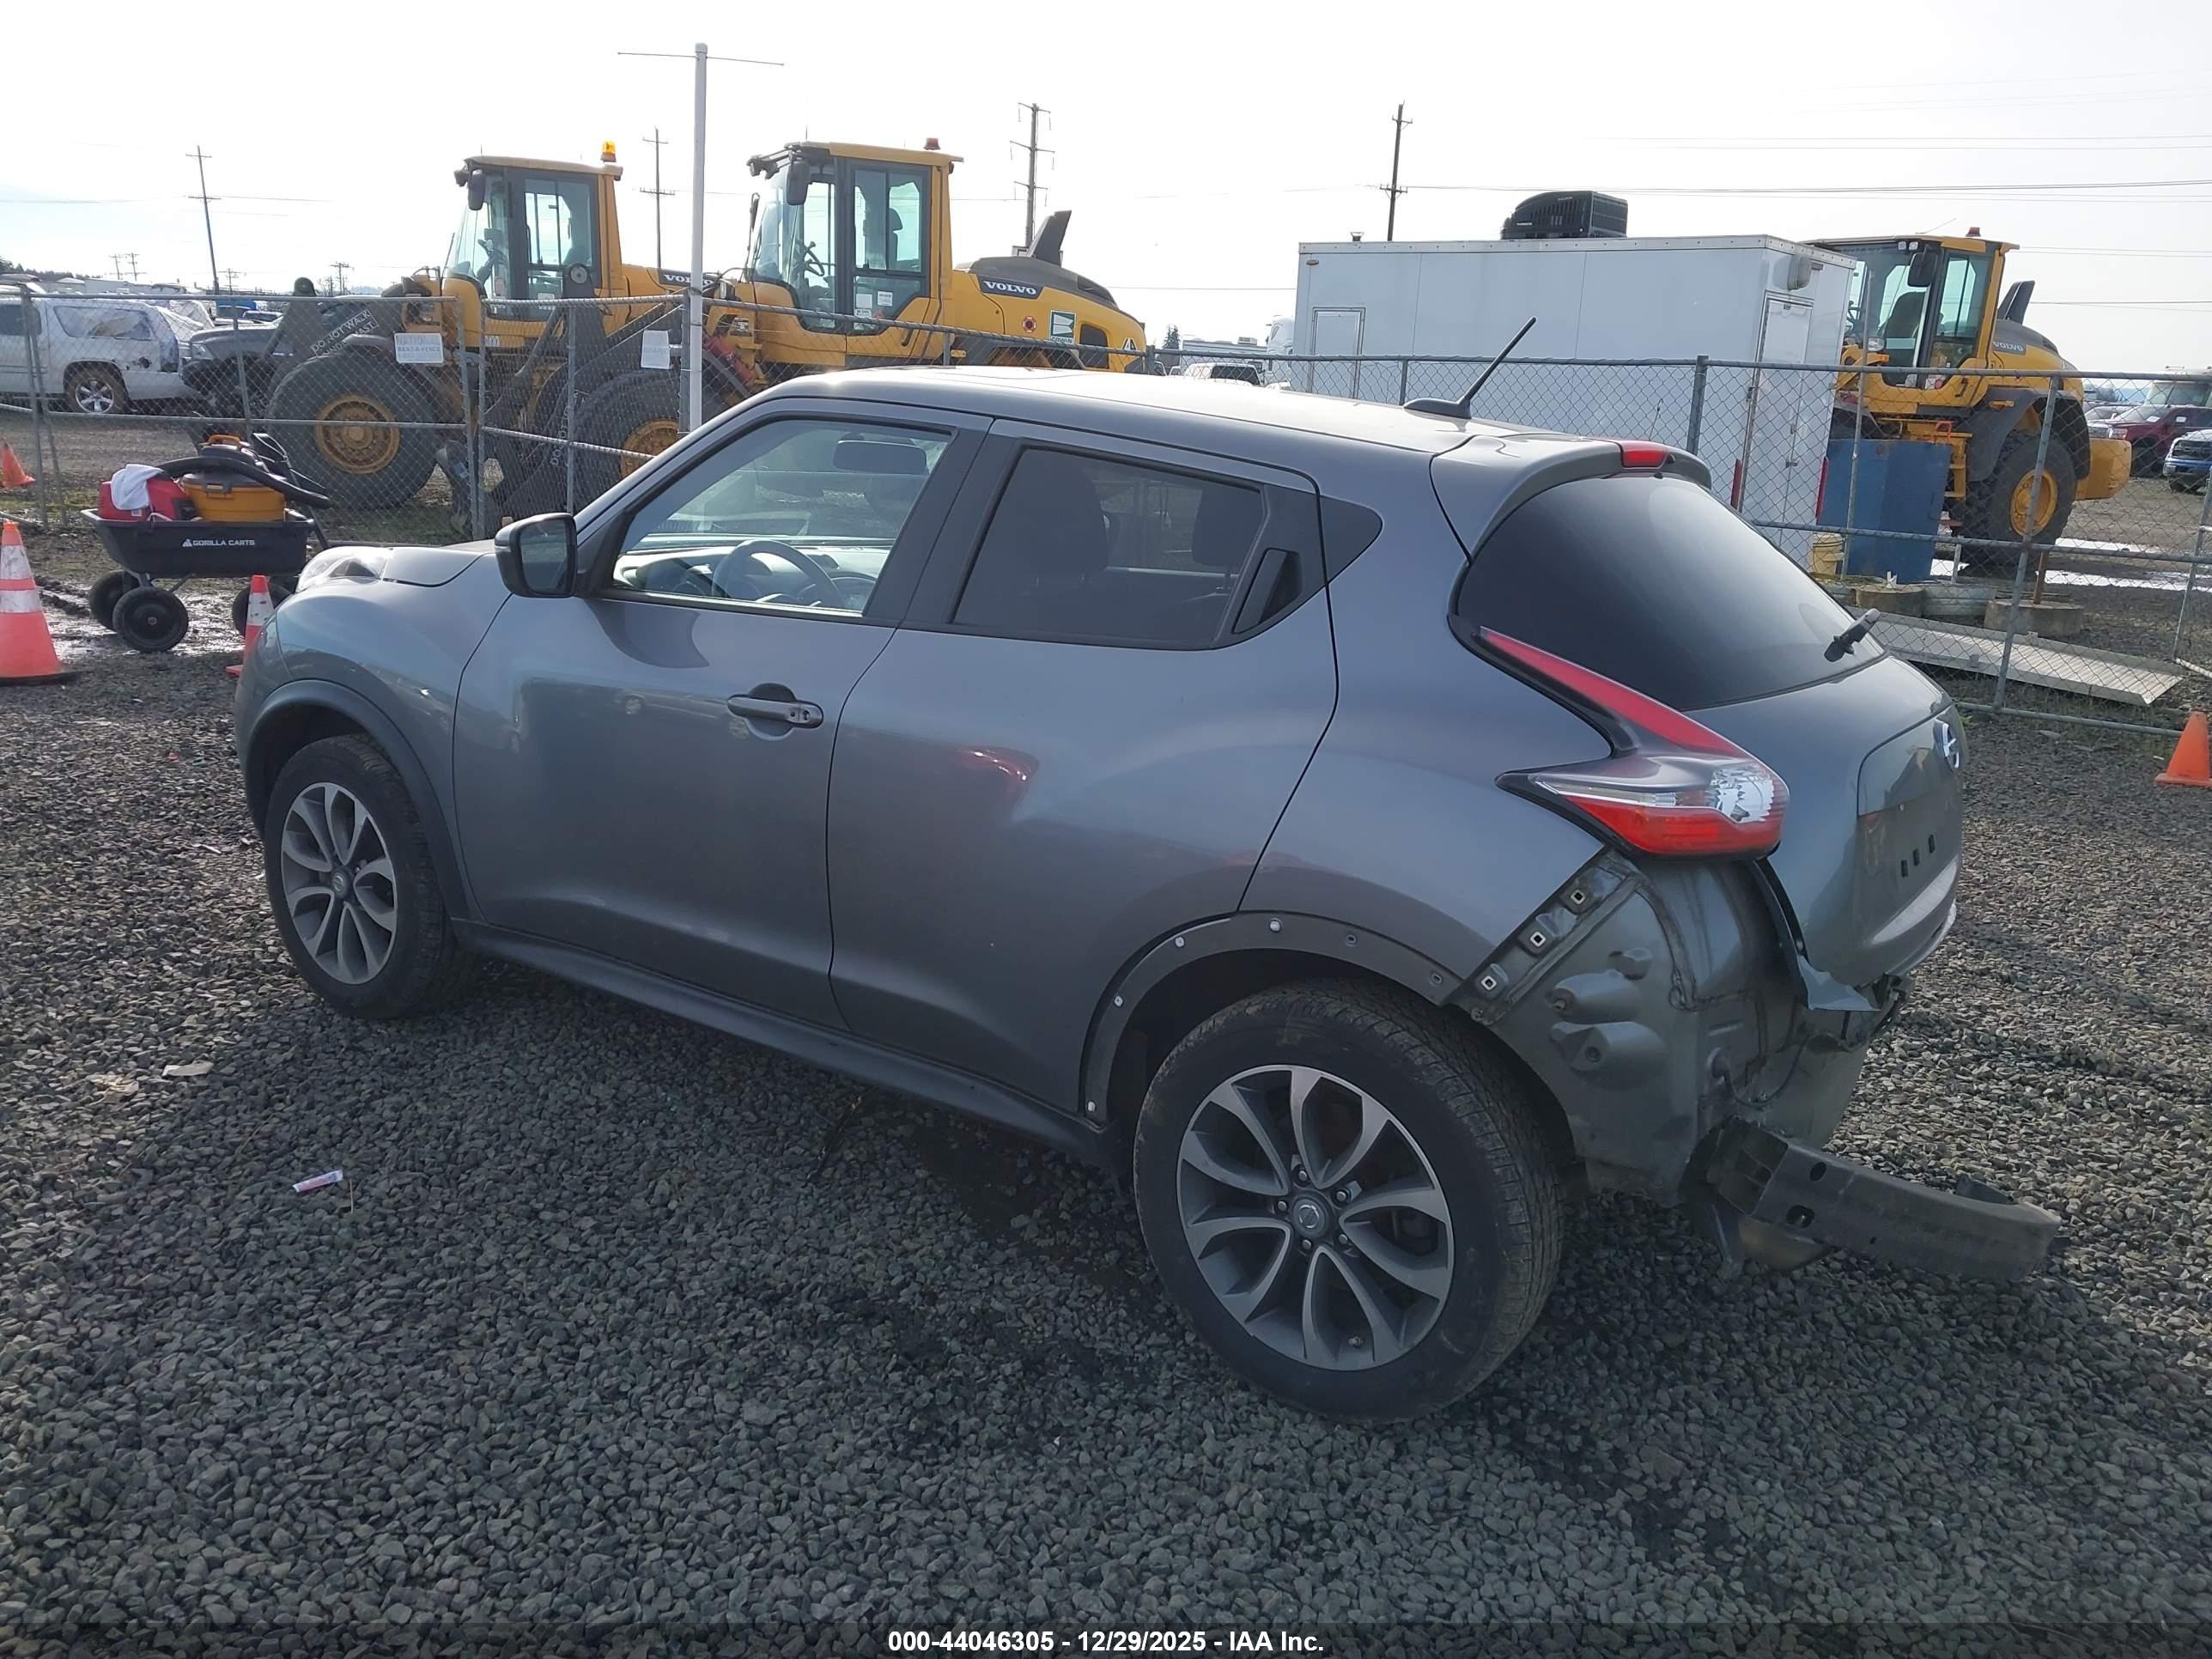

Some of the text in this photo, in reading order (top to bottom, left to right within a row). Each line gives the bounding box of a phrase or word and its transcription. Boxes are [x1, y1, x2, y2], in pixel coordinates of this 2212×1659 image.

[982, 280, 1036, 295] VOLVO
[309, 310, 371, 355] DO NOT WALK
[1993, 342, 2024, 351] VOLVO
